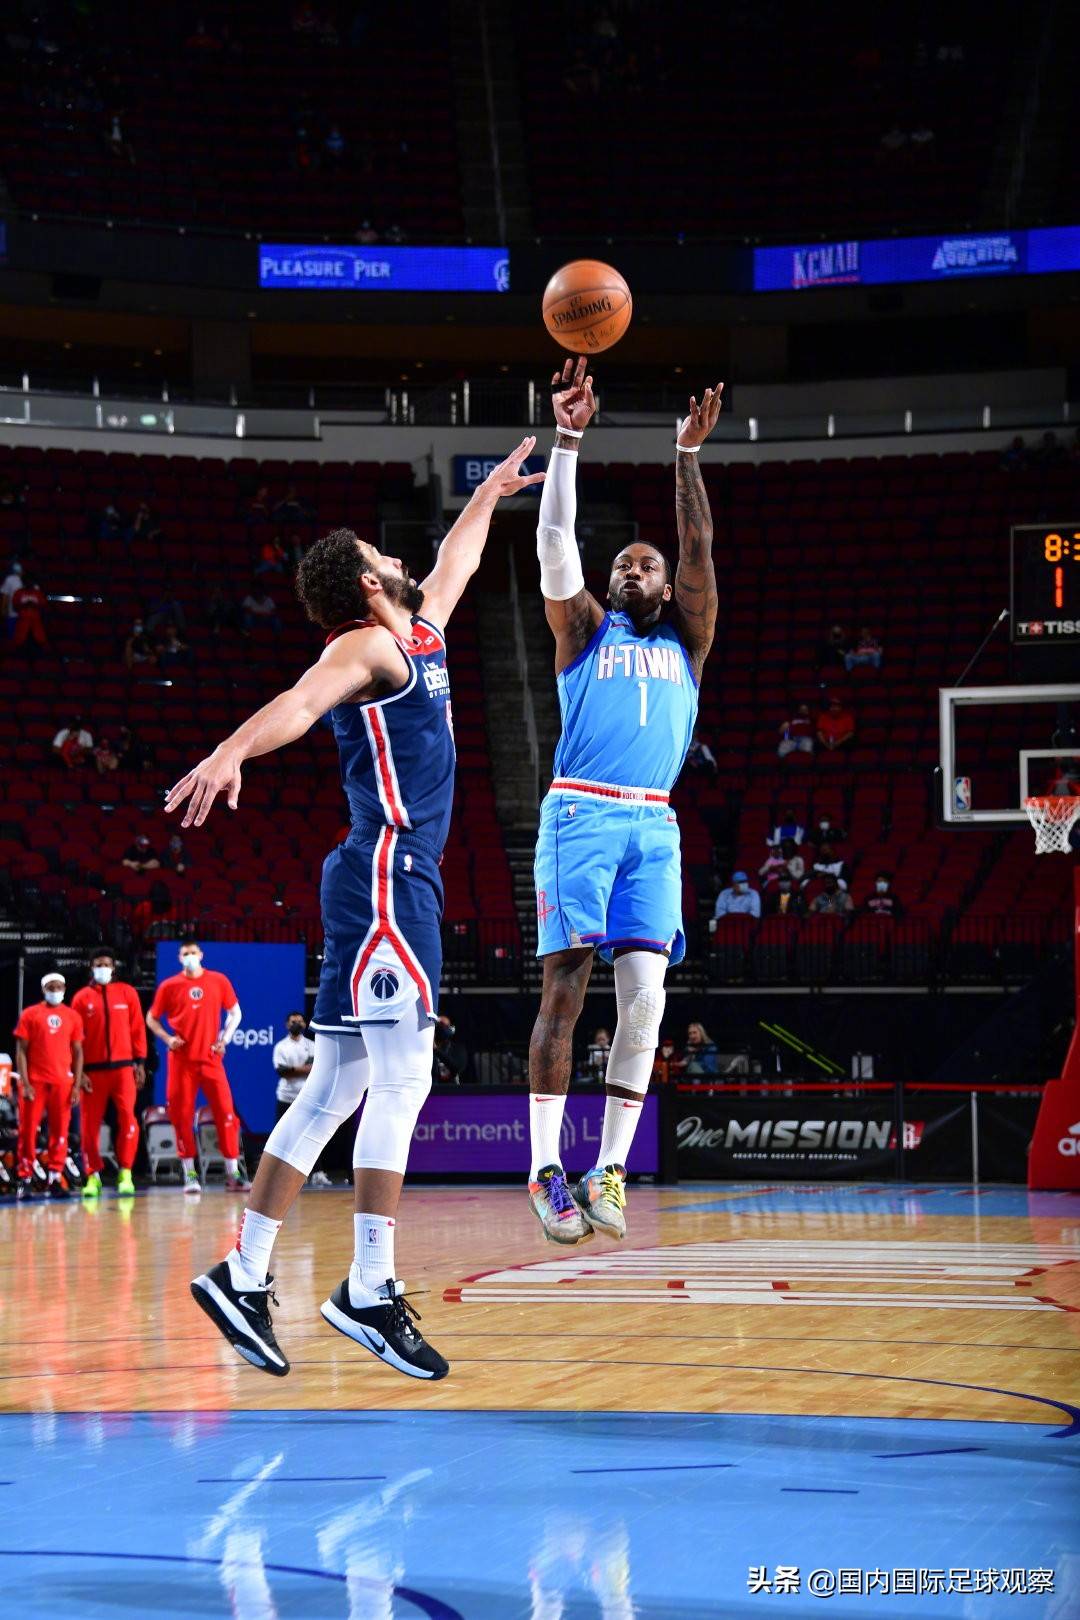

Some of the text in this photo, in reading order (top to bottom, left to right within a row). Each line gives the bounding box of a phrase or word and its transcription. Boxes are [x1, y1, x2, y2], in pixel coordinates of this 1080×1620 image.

[354, 260, 390, 281] PIER
[552, 295, 613, 329] SPALDING
[597, 644, 681, 686] H-TOWN
[638, 681, 648, 727] 1
